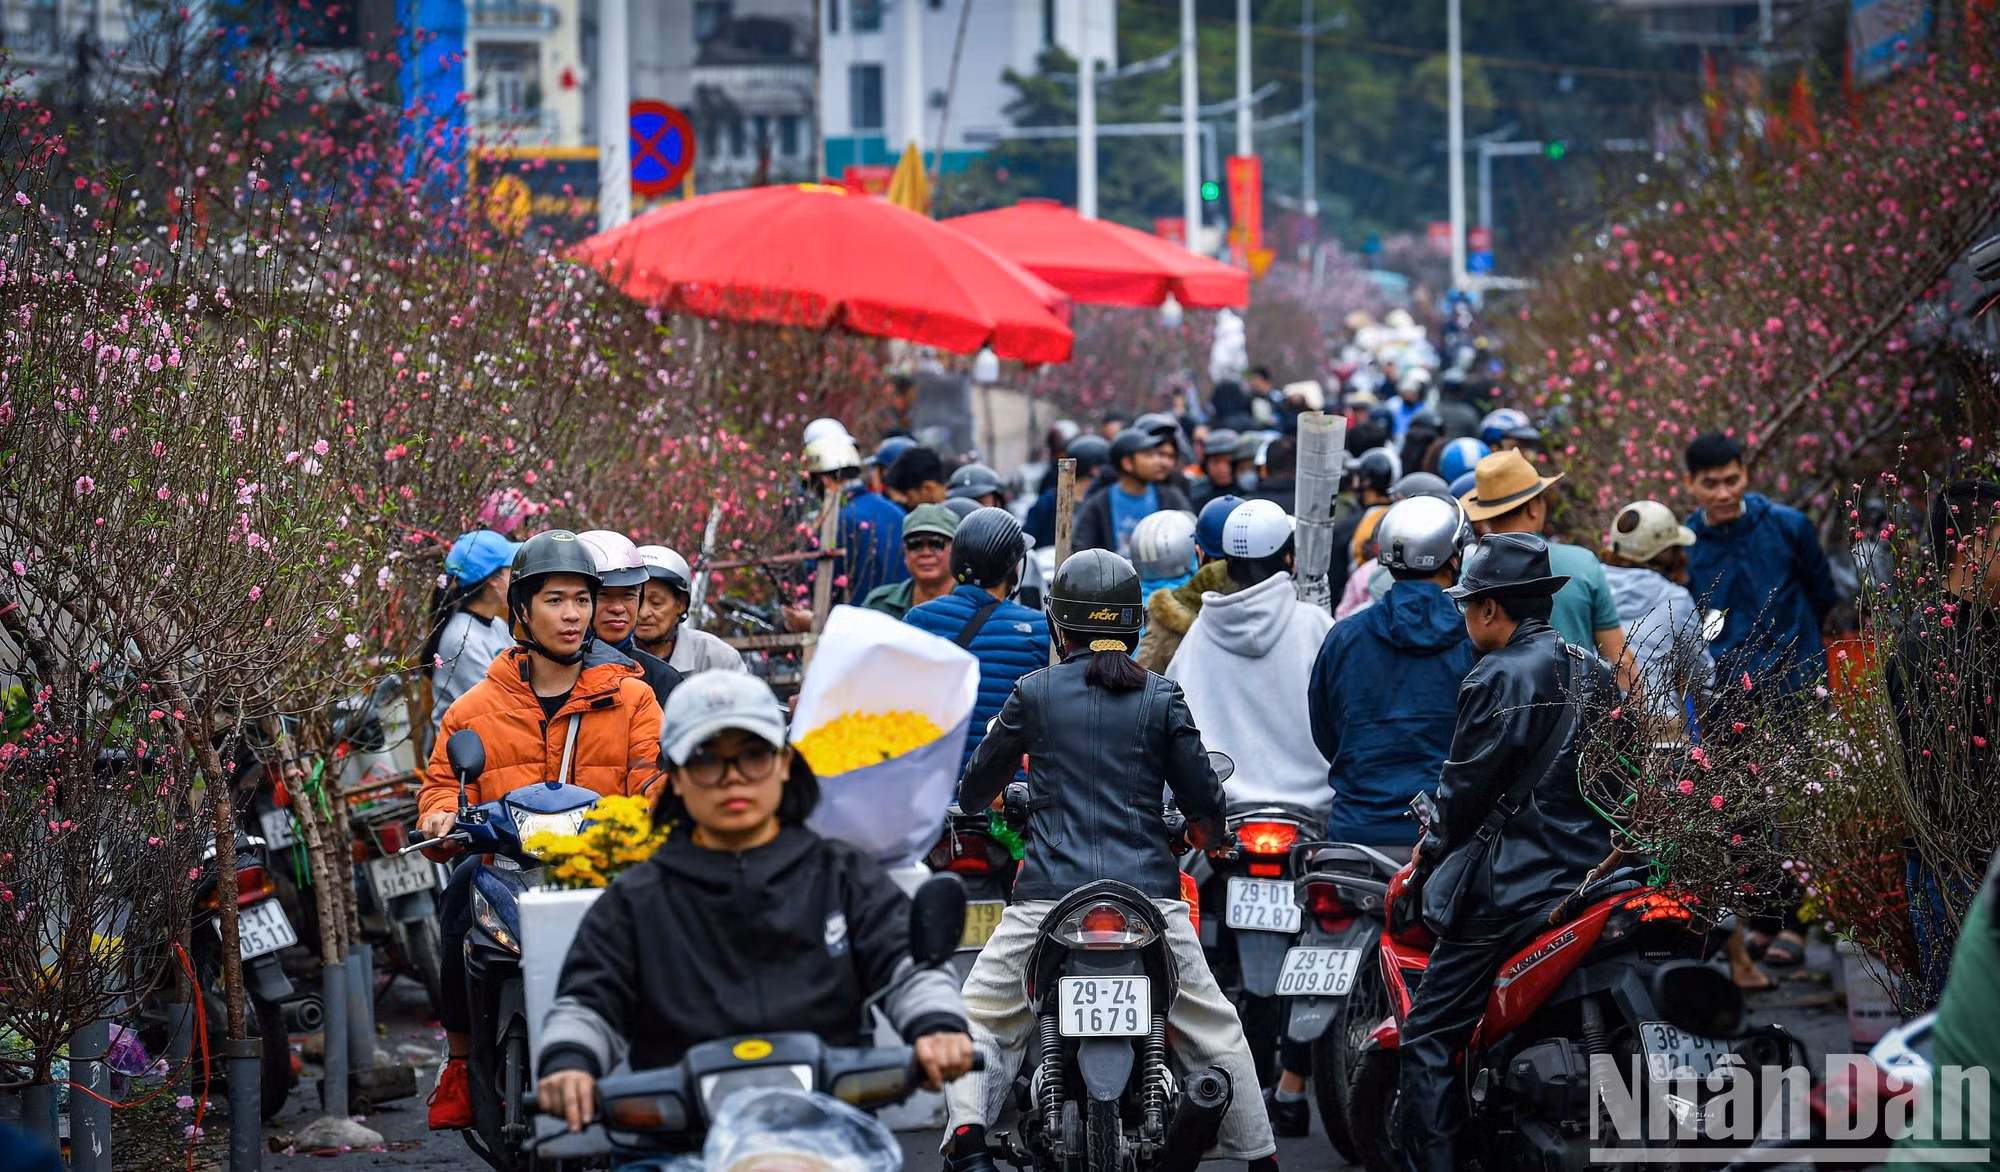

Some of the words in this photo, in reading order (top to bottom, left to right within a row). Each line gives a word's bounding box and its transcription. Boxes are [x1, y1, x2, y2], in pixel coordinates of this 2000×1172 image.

[1239, 883, 1289, 905] 29-D1
[1232, 904, 1295, 928] 872.87
[239, 924, 290, 953] 05.11
[1293, 951, 1349, 971] 29-C1
[1072, 980, 1137, 1005] 29-Z4
[1282, 972, 1349, 992] 009.06
[1074, 1007, 1138, 1032] 1679
